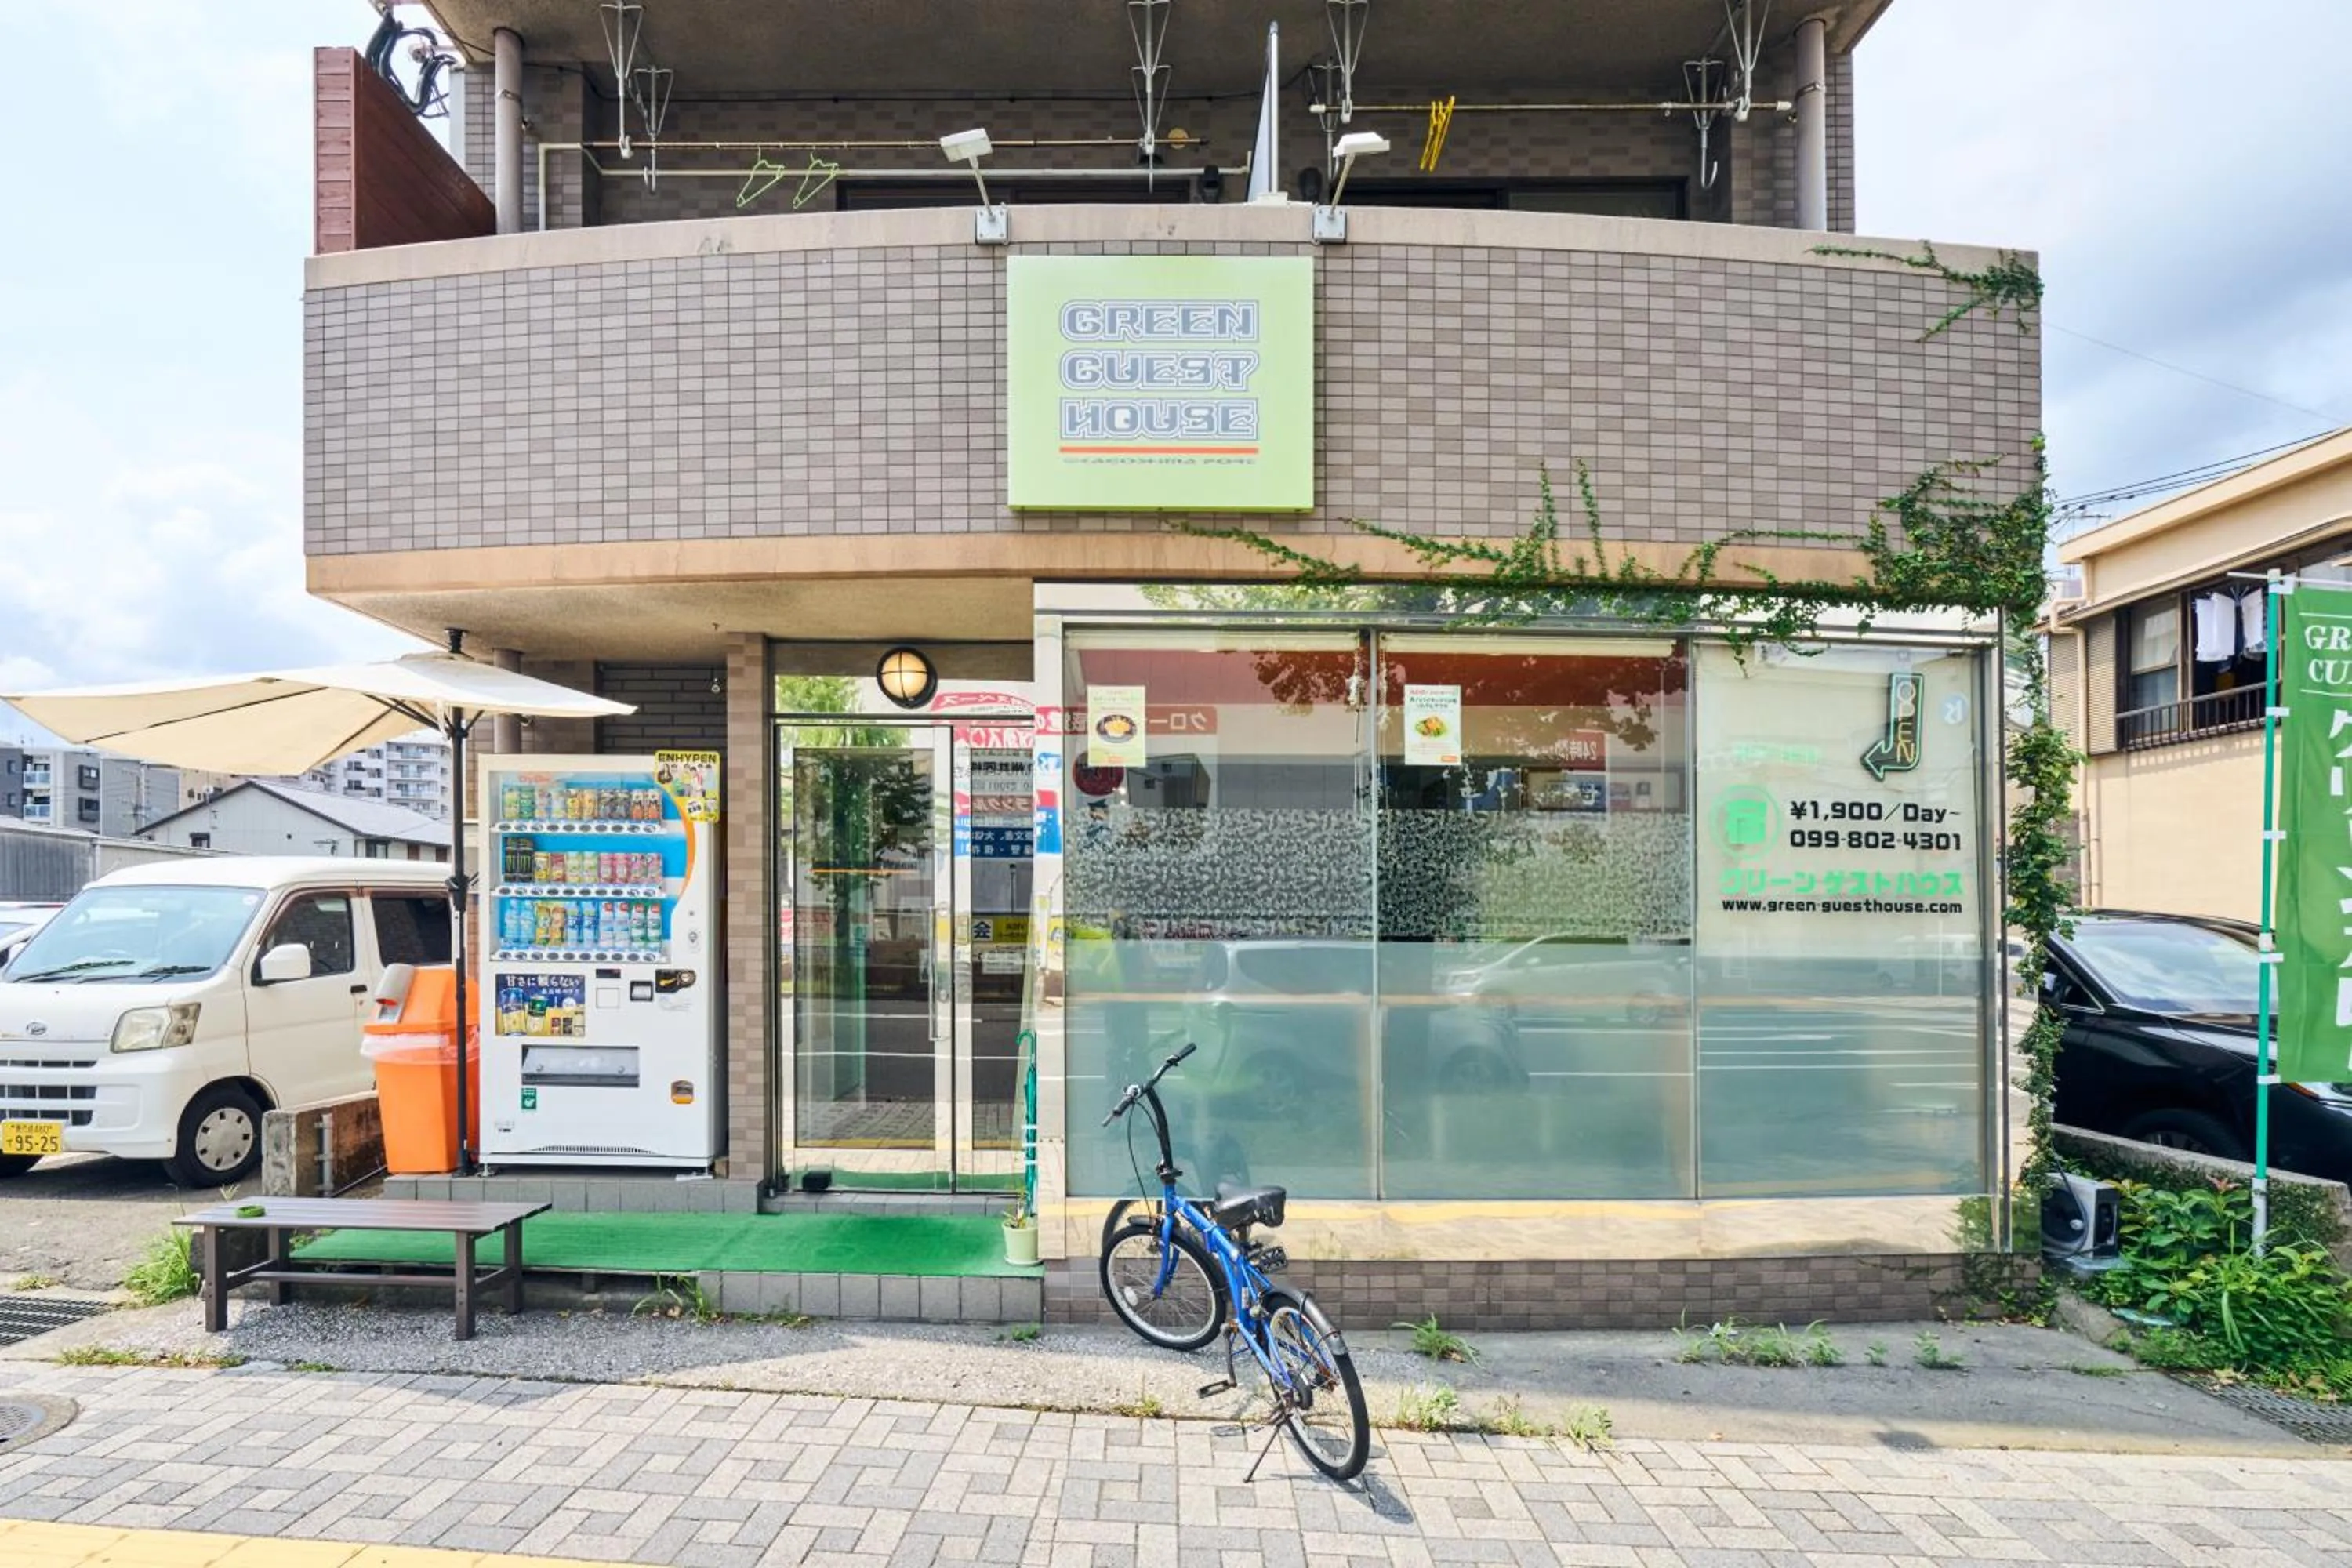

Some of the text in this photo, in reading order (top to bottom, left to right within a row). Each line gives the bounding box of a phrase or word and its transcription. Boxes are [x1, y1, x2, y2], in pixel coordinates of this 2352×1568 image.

[1059, 299, 1259, 343] GREEN
[1059, 348, 1259, 391] GUEST
[1059, 397, 1259, 441] HOUSE
[2307, 658, 2352, 685] CU
[1895, 680, 1917, 764] OPEN
[658, 752, 717, 763] ENHYPEN
[1789, 829, 1962, 851] 099-802-4301
[1721, 898, 1963, 914] www.green-guesthouse.com
[15, 1134, 59, 1152] 95-25
